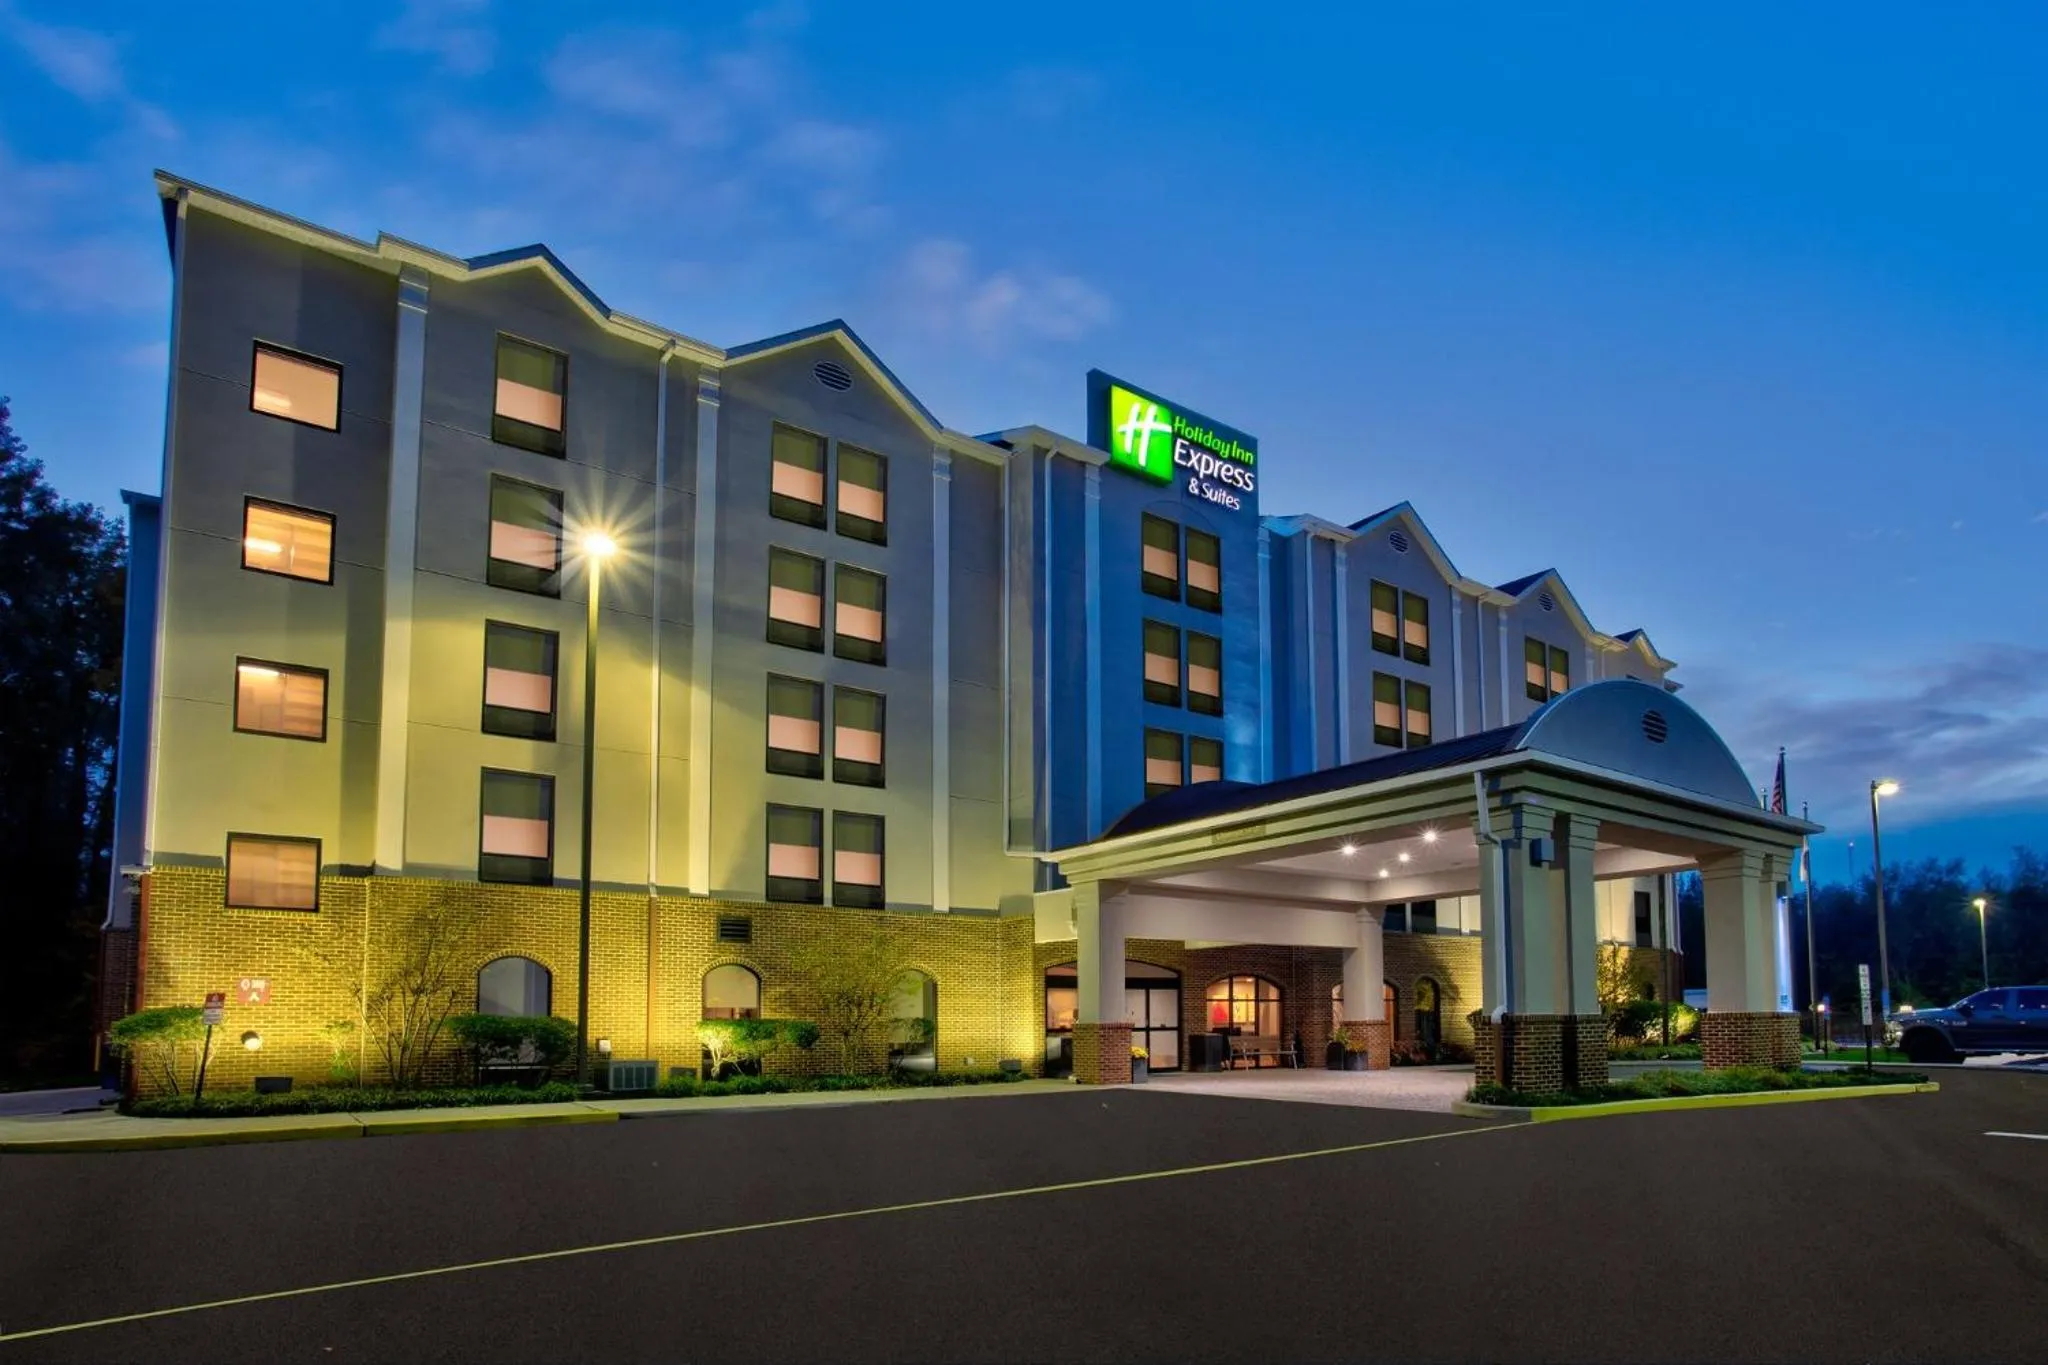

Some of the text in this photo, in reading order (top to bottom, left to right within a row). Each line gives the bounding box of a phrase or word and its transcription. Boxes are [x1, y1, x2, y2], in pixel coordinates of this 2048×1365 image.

[1118, 403, 1172, 467] H
[1174, 415, 1254, 465] Holiday Inn
[1174, 438, 1255, 492] Express
[1188, 477, 1240, 510] & Suites
